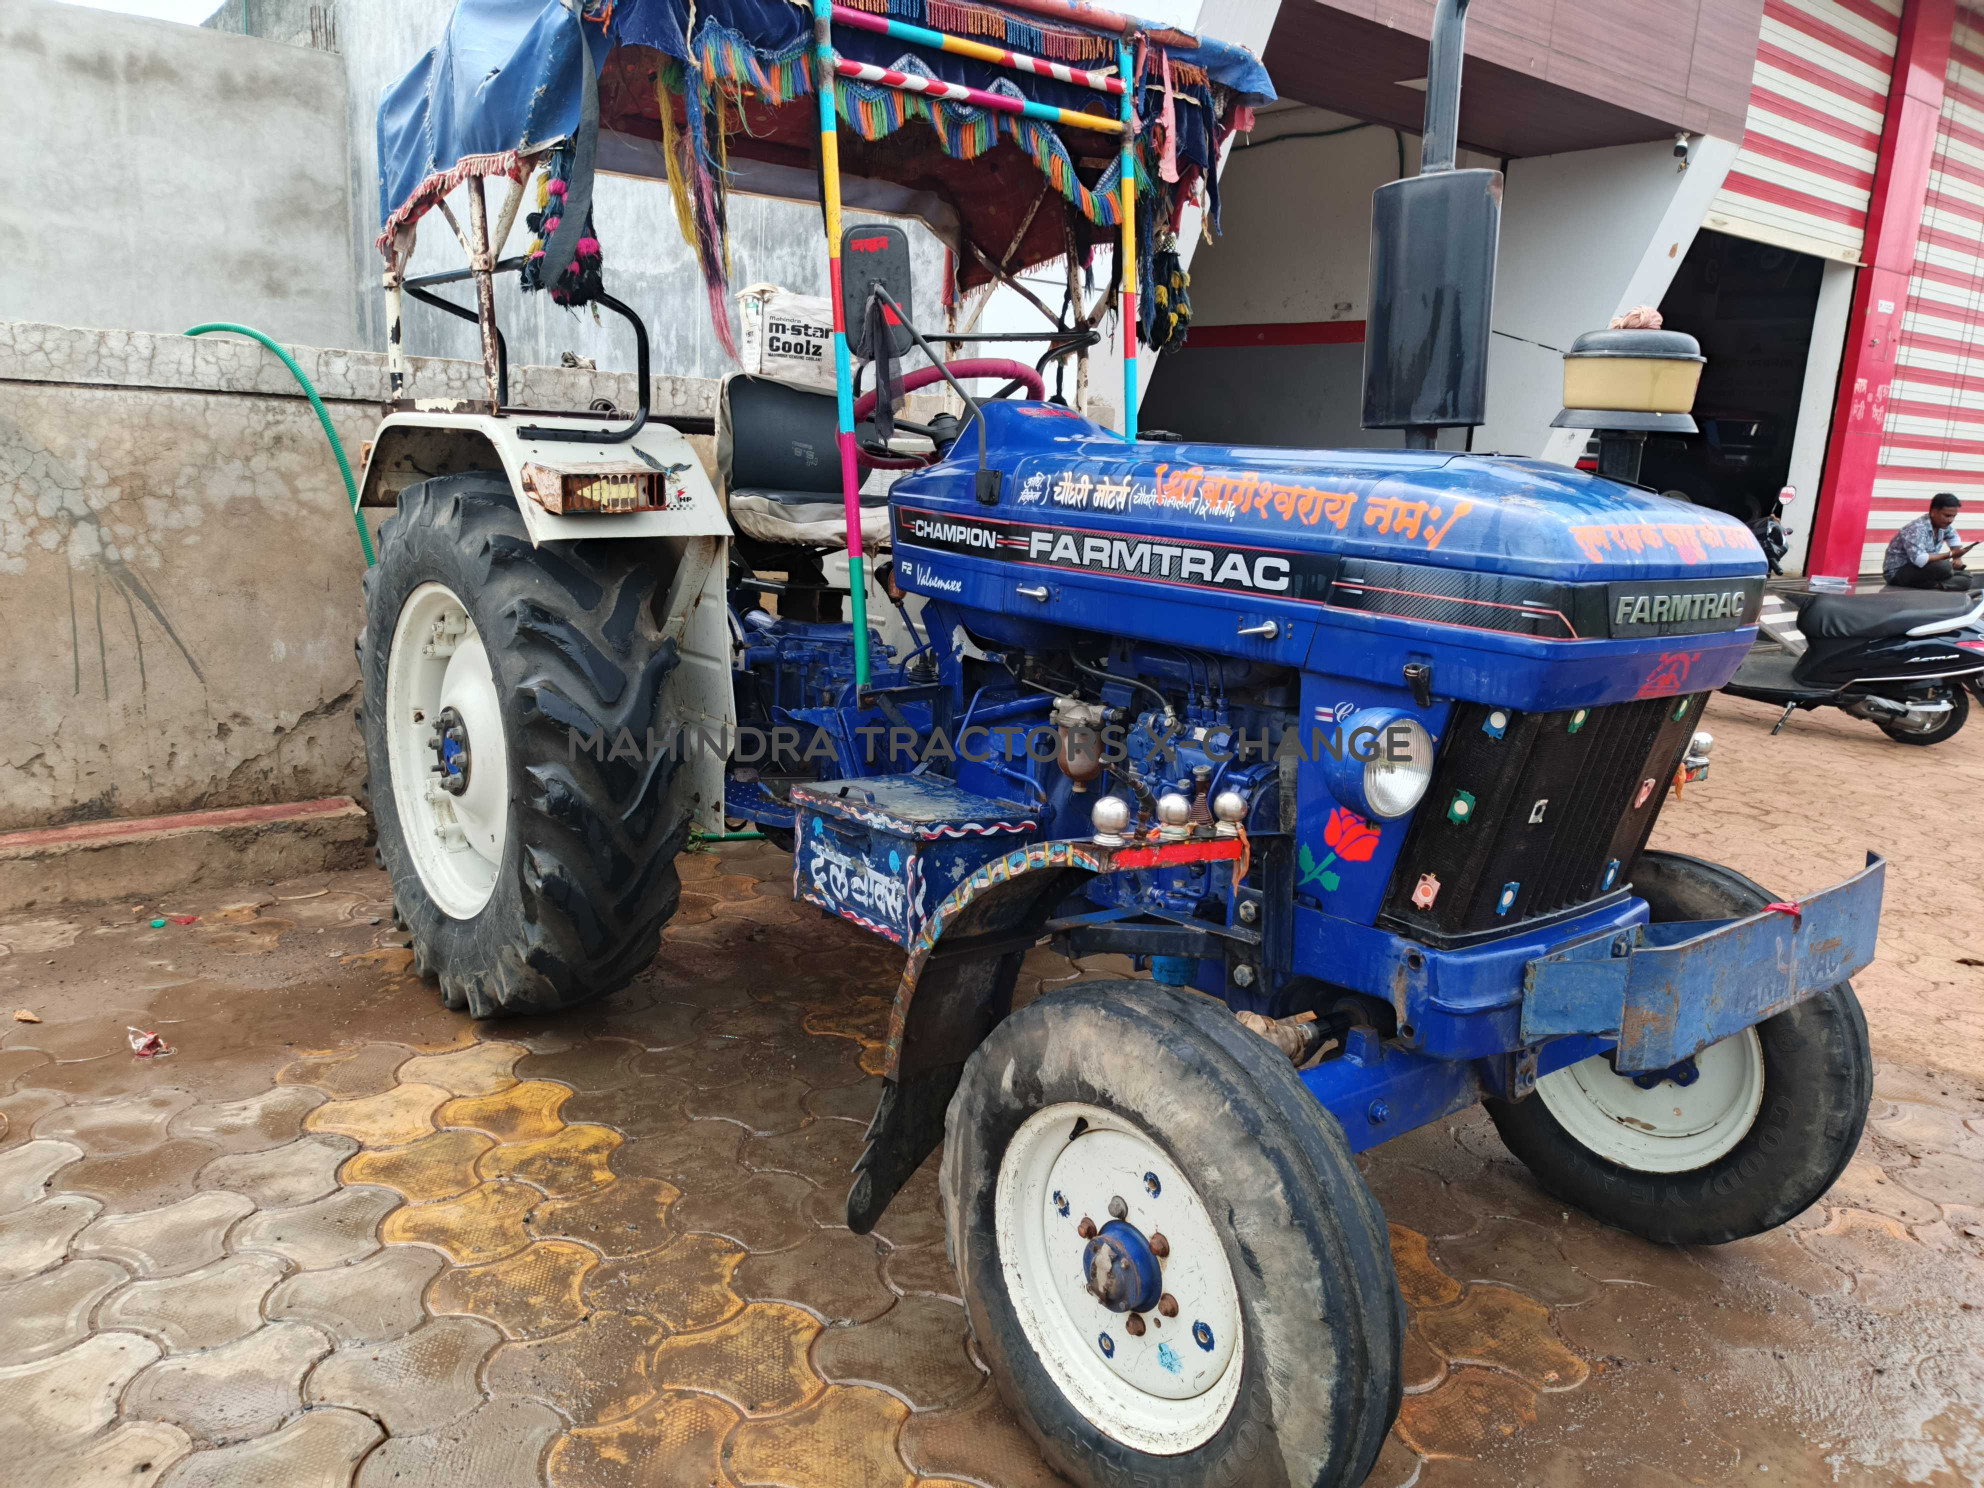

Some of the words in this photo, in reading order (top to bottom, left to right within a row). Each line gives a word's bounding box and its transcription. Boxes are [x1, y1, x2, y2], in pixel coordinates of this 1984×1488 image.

[768, 336, 823, 356] Coolz
[1053, 471, 1093, 508] चौधरी
[1093, 475, 1131, 511] मोटर्स
[915, 519, 996, 549] CHAMPION
[1030, 531, 1290, 591] FARMTRAC
[901, 561, 913, 576] F2
[916, 563, 962, 594] Valuemaxx
[1615, 591, 1745, 625] FARMTRAC
